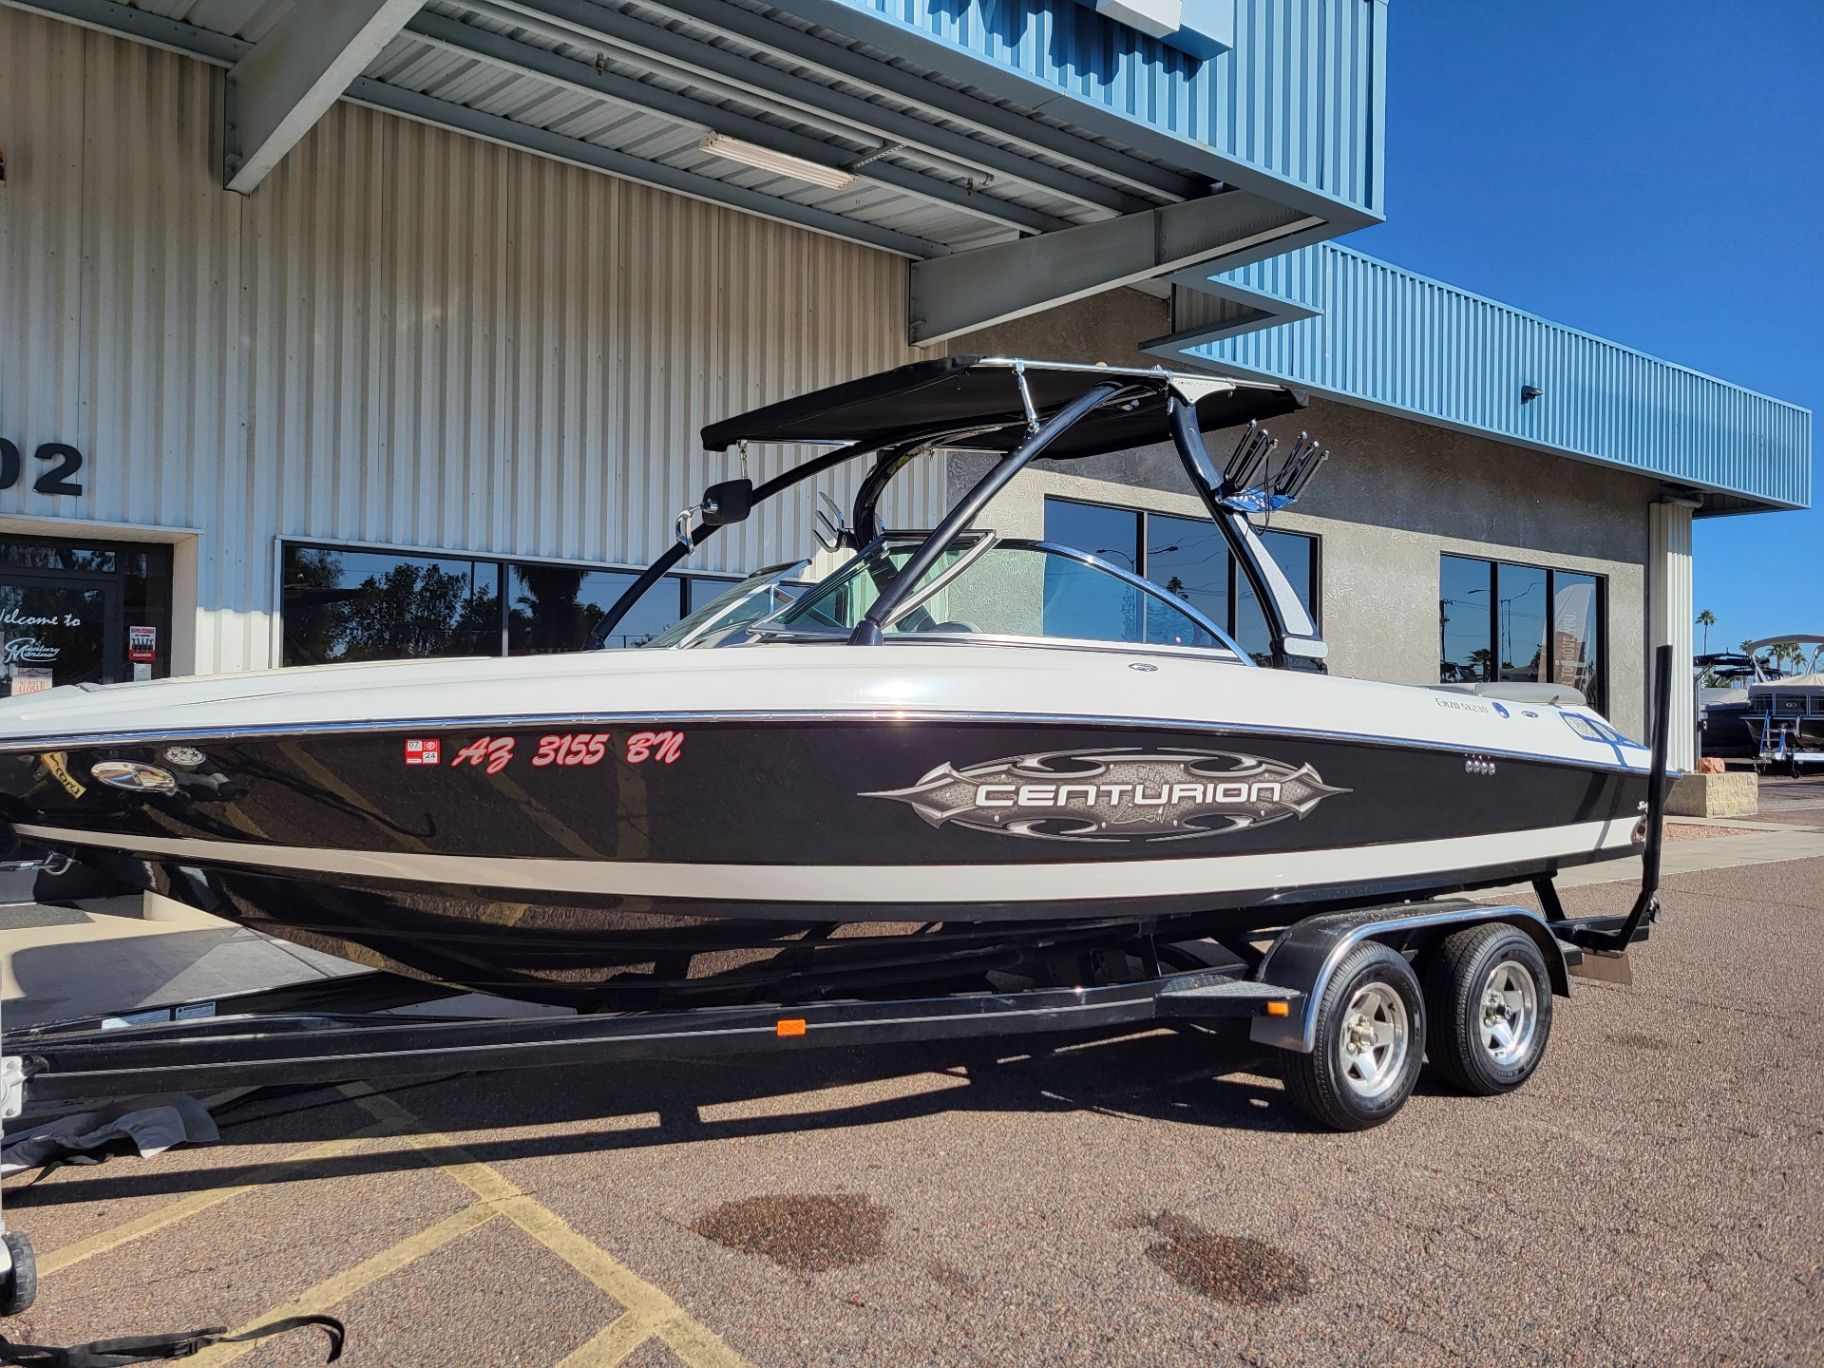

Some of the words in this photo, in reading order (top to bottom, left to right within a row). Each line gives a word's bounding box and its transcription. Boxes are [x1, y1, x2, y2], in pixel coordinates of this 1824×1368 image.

[64, 613, 81, 627] to
[450, 735, 516, 777] AZ
[531, 732, 611, 767] 3155
[625, 730, 685, 765] BN
[974, 782, 1282, 808] CENTURION
